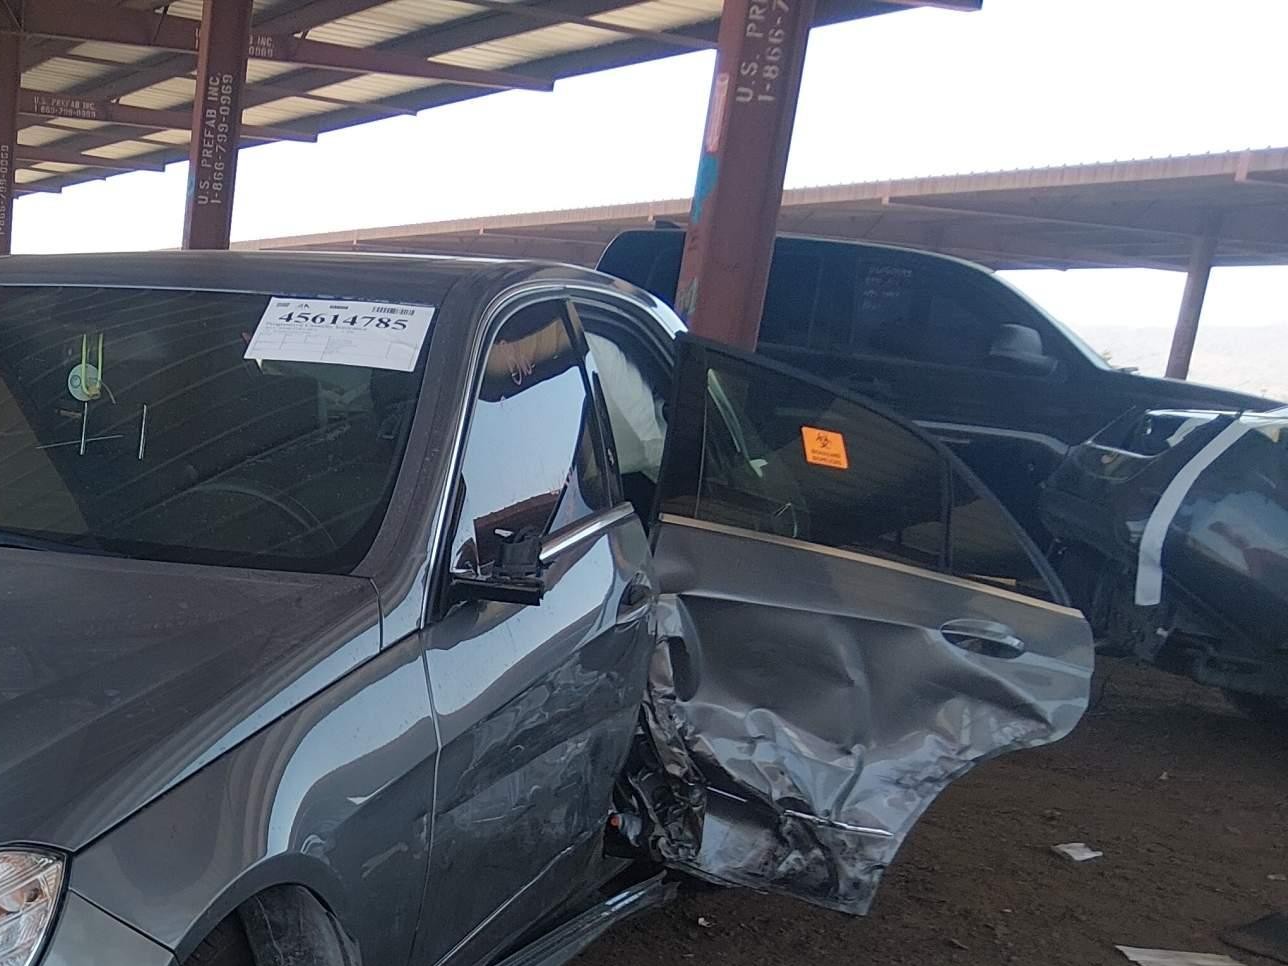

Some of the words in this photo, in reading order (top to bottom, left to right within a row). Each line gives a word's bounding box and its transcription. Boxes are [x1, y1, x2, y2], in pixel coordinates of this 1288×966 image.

[735, 53, 760, 103] U.S.
[201, 108, 217, 167] PREFAB
[211, 74, 233, 204] 1-866-799-0969
[198, 173, 211, 205] U.S.
[278, 311, 409, 331] 45614785
